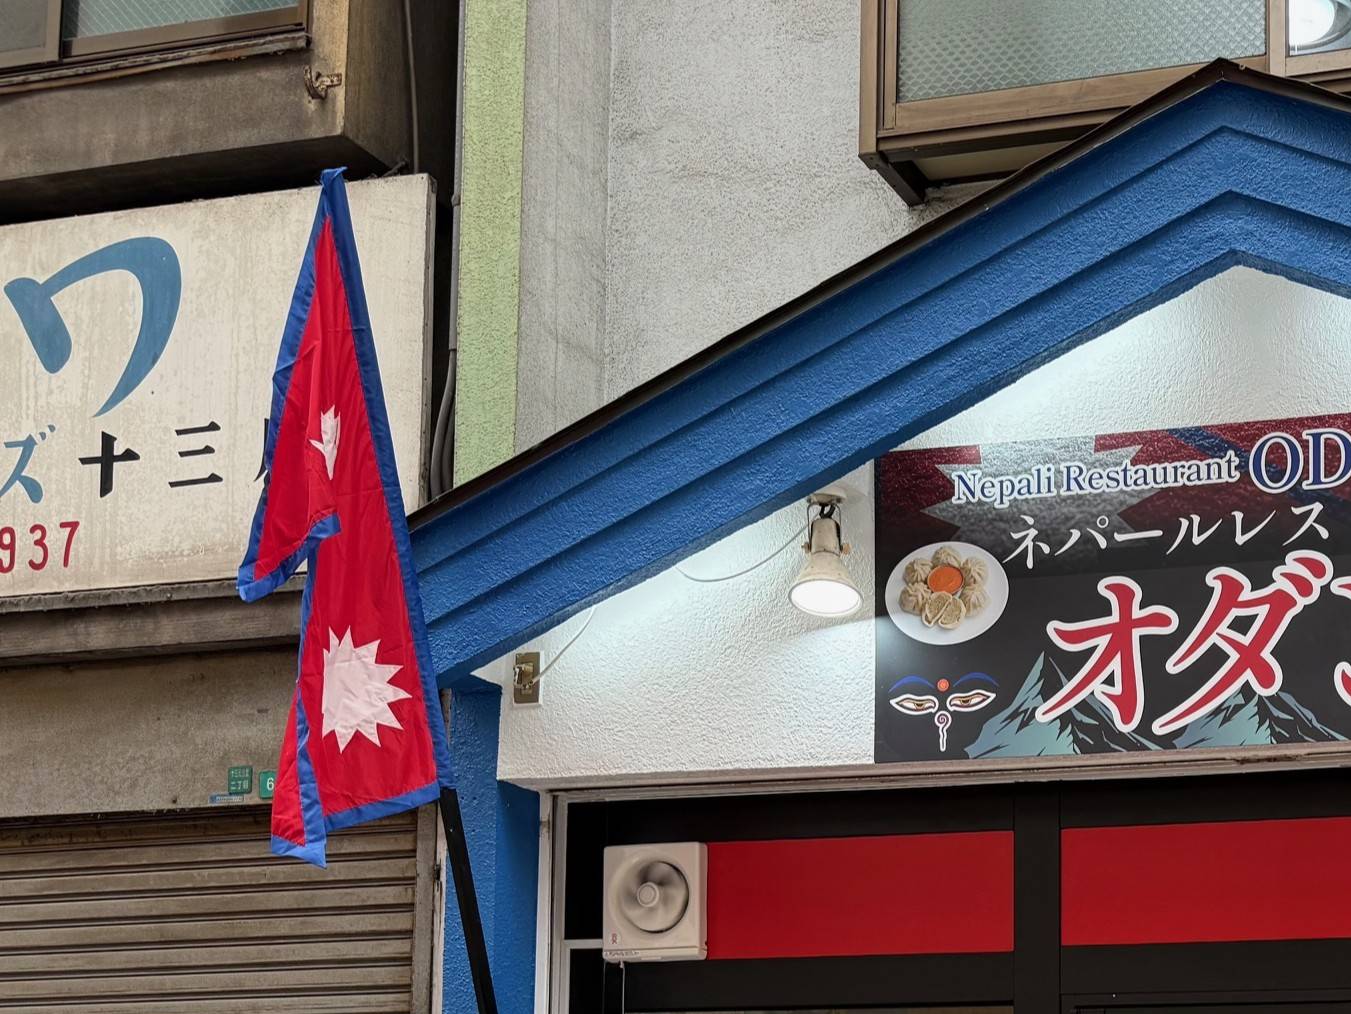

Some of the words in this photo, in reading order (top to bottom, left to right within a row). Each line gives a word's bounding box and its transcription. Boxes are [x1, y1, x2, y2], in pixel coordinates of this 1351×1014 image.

[952, 464, 1056, 509] Nepali
[1062, 449, 1241, 494] Restaurant
[0, 521, 80, 574] 937
